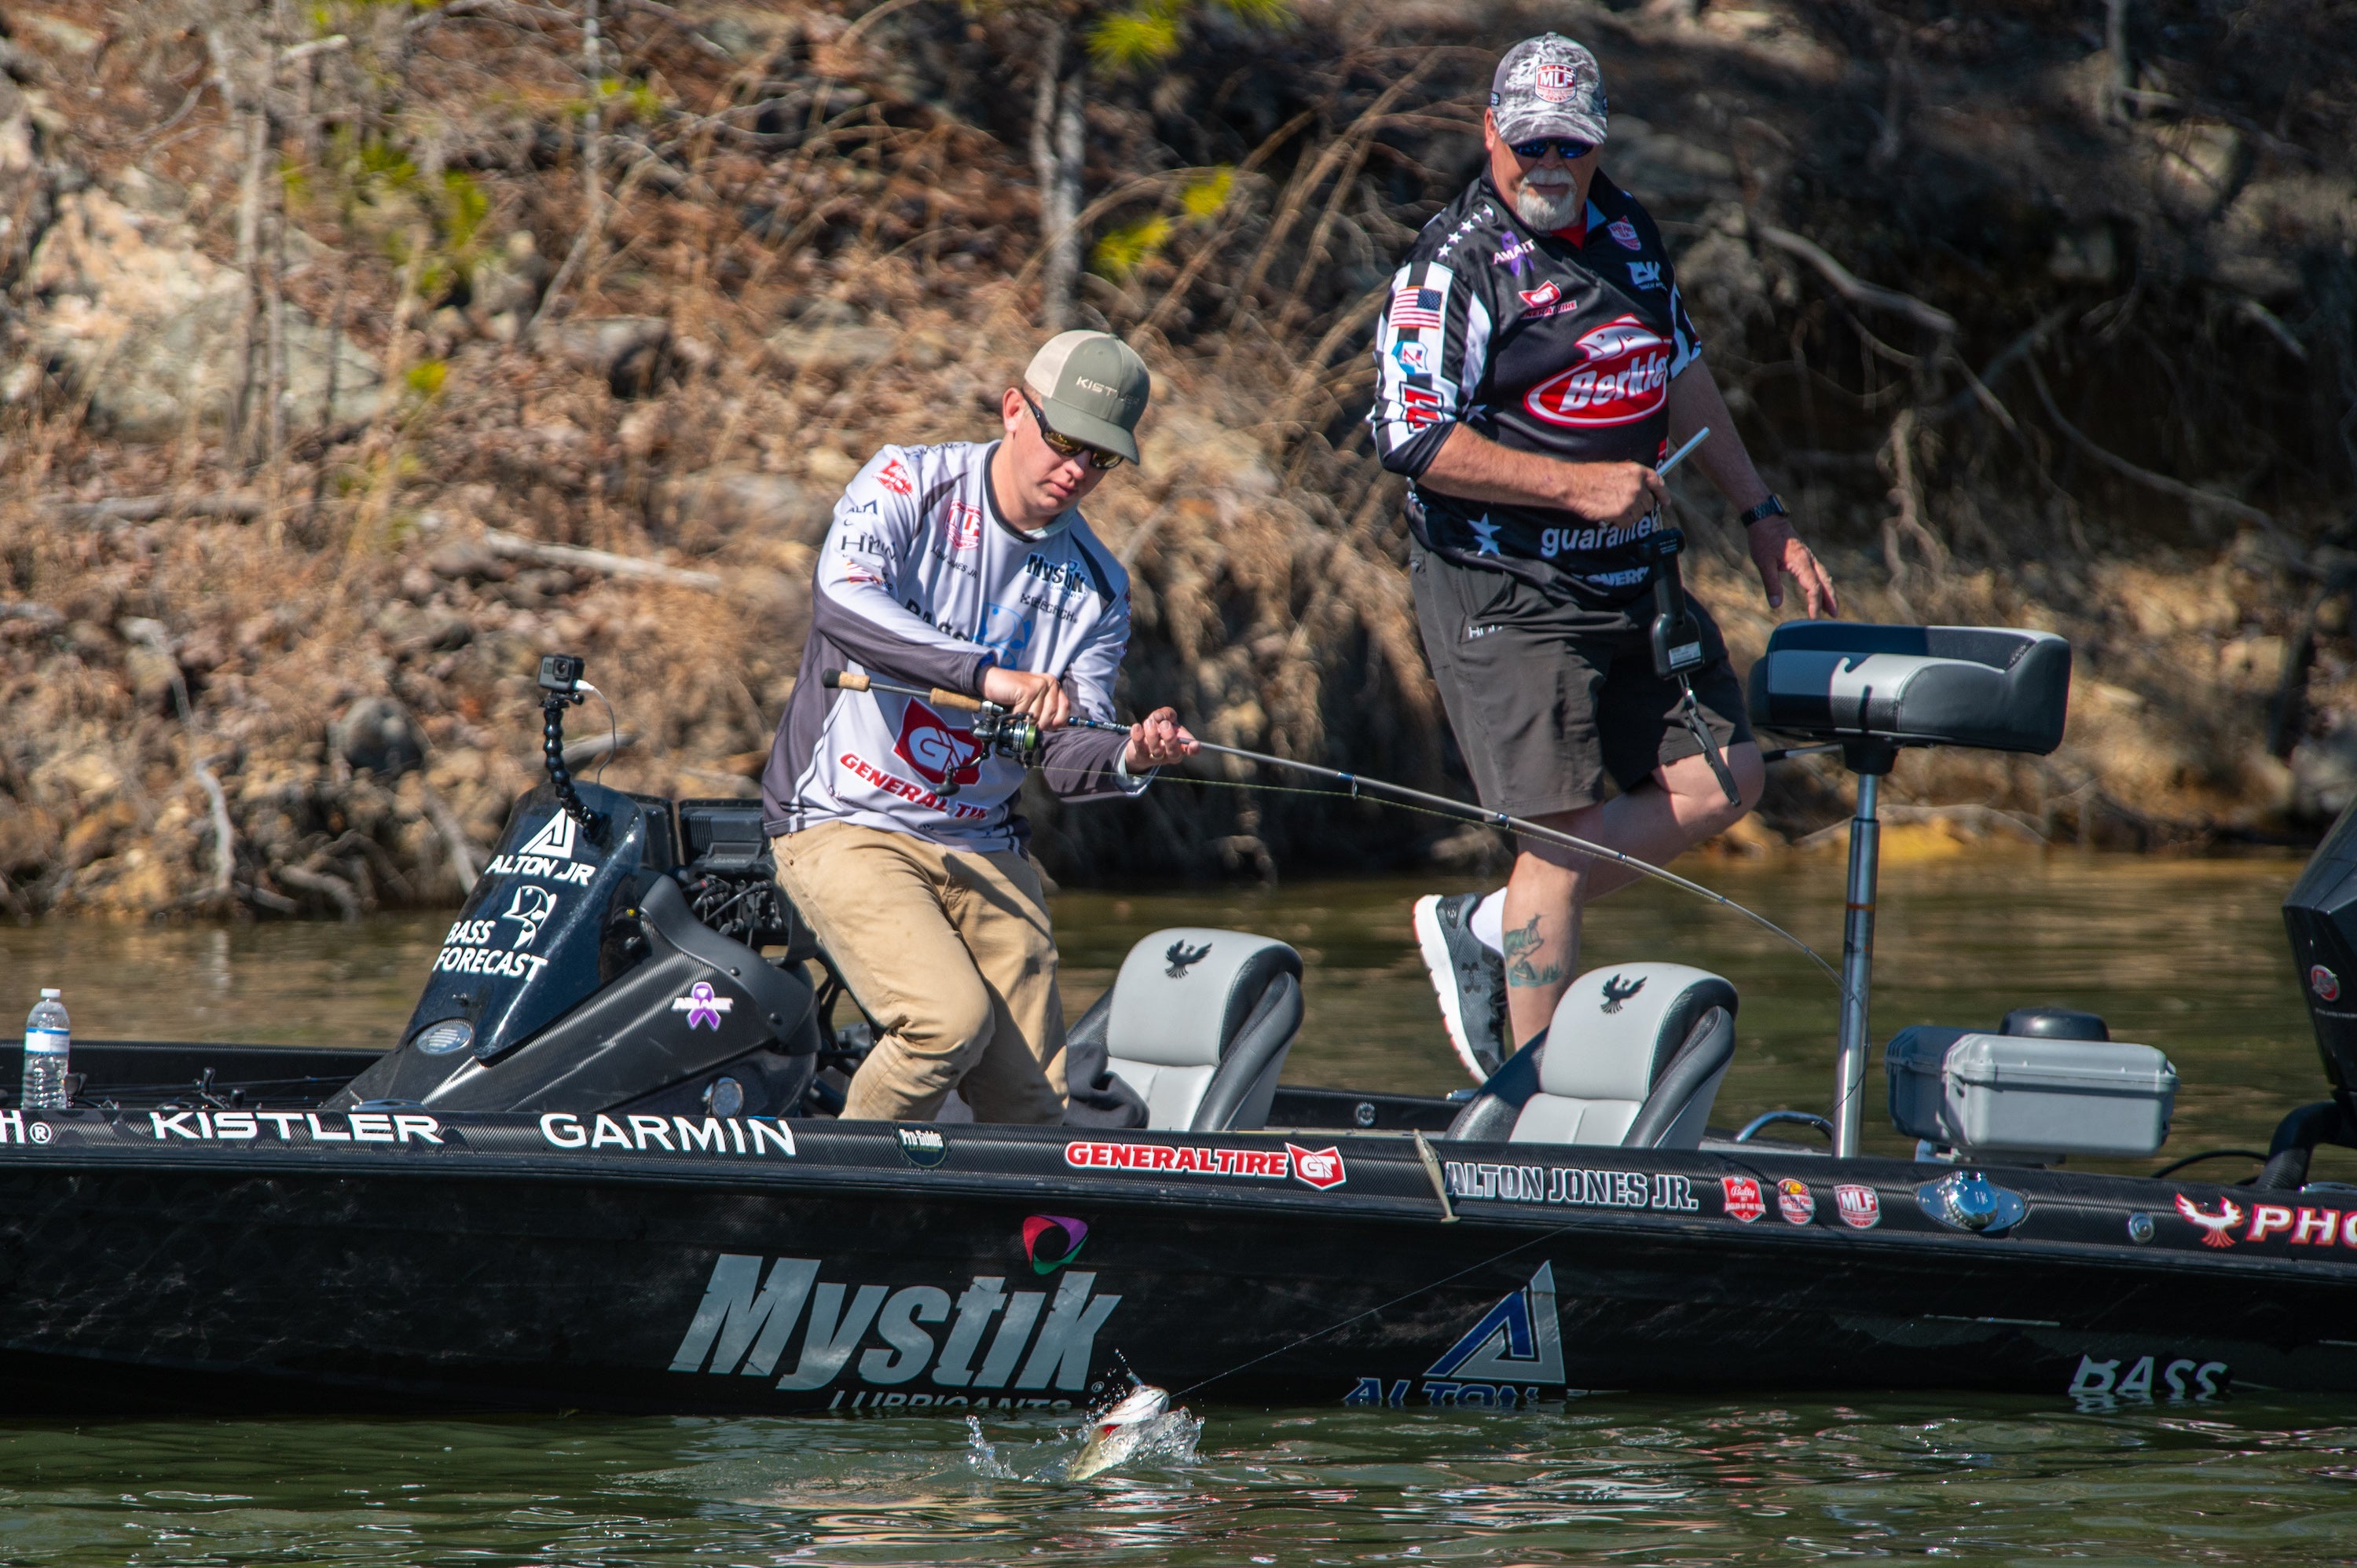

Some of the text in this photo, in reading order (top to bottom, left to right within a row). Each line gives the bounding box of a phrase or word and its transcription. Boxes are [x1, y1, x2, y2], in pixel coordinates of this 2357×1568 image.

[1539, 71, 1574, 88] MLF
[1558, 300, 1578, 313] TIRE
[1076, 376, 1140, 403] KISTER
[1559, 351, 1670, 412] Berkle
[967, 569, 978, 578] JR
[908, 726, 976, 776] GT
[840, 752, 949, 813] GENERAL
[955, 801, 988, 820] TIR
[483, 854, 596, 887] ALTON JR
[443, 919, 497, 945] BASS
[432, 946, 548, 983] FORECAST
[148, 1112, 445, 1144] KISTLER
[539, 1113, 797, 1157] GARMIN
[1300, 1155, 1336, 1178] GT
[1443, 1161, 1699, 1211] ALTON JONES JR.
[1731, 1185, 1755, 1200] Bally
[1840, 1191, 1875, 1211] MLF
[667, 1253, 1124, 1391] Mystik
